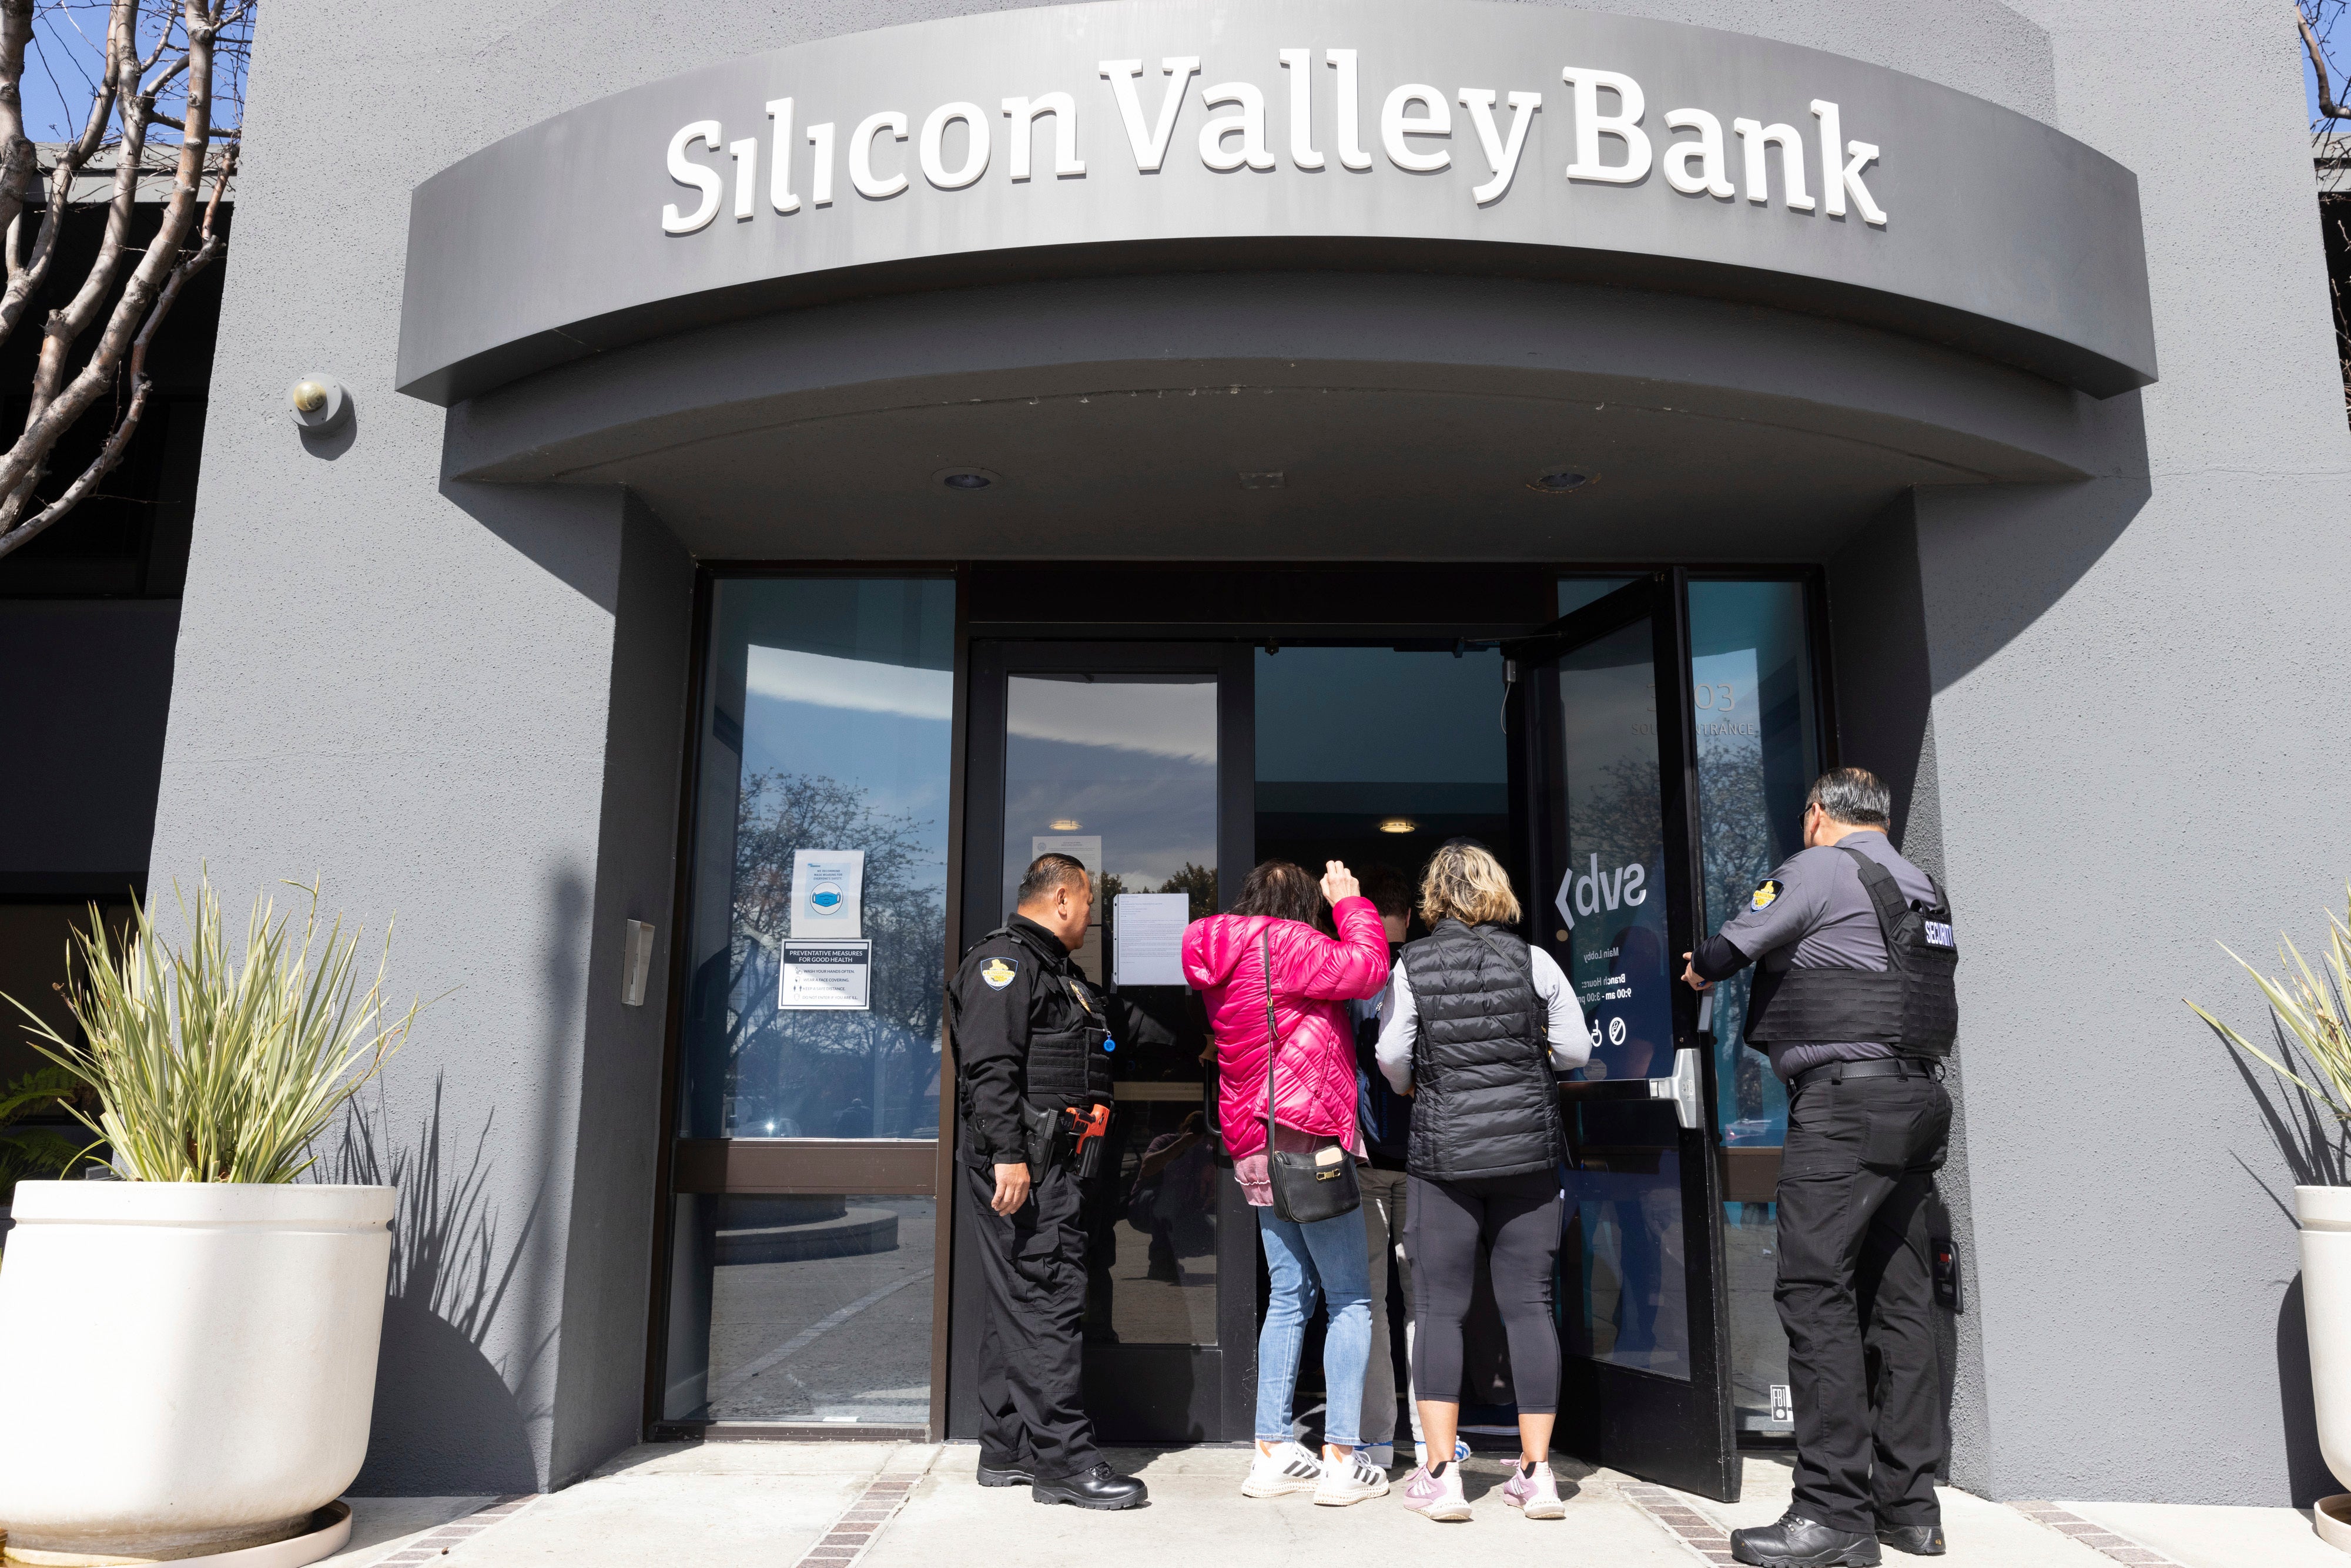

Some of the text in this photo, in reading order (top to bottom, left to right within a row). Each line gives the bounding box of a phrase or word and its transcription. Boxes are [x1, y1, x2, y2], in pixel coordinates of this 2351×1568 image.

[662, 48, 1887, 234] Silicon Valley Bank
[1696, 723, 1754, 735] NTRANCE
[1925, 921, 1954, 947] SECURITY
[1773, 1388, 1786, 1407] FBI
